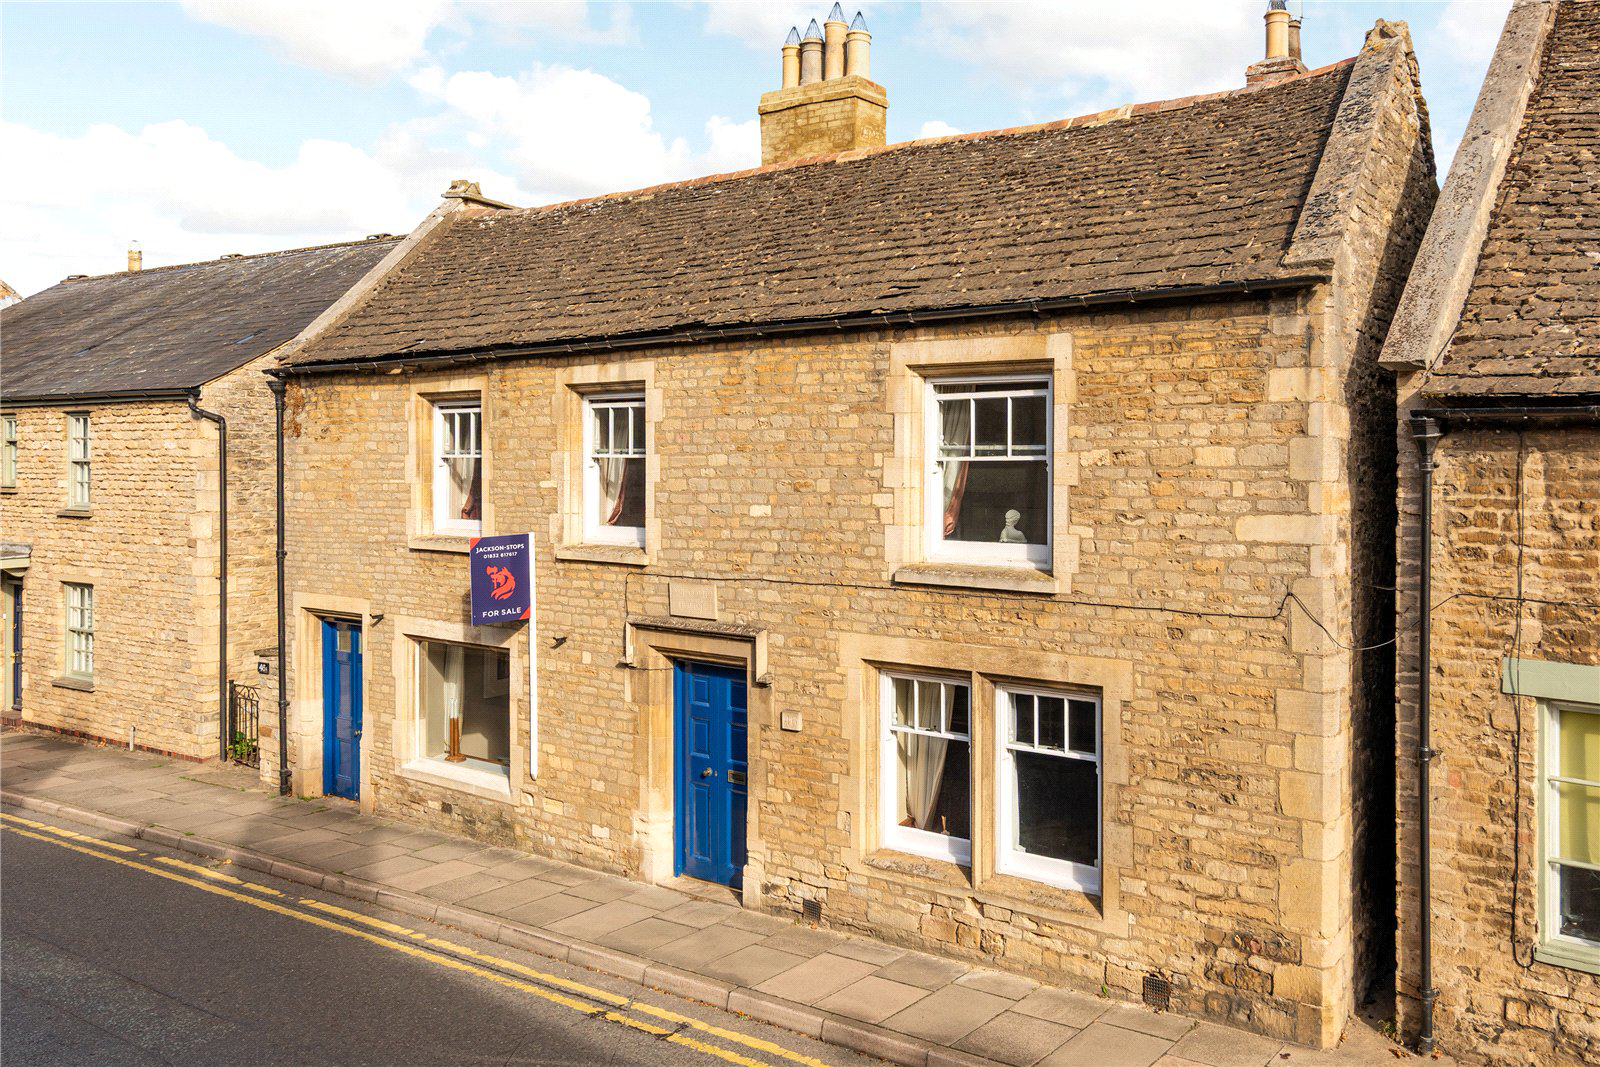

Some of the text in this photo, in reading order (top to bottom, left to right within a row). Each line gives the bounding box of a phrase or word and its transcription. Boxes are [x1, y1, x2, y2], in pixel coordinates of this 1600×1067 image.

[476, 543, 525, 554] JACKSON-STOPS
[482, 606, 522, 618] FOR SALE
